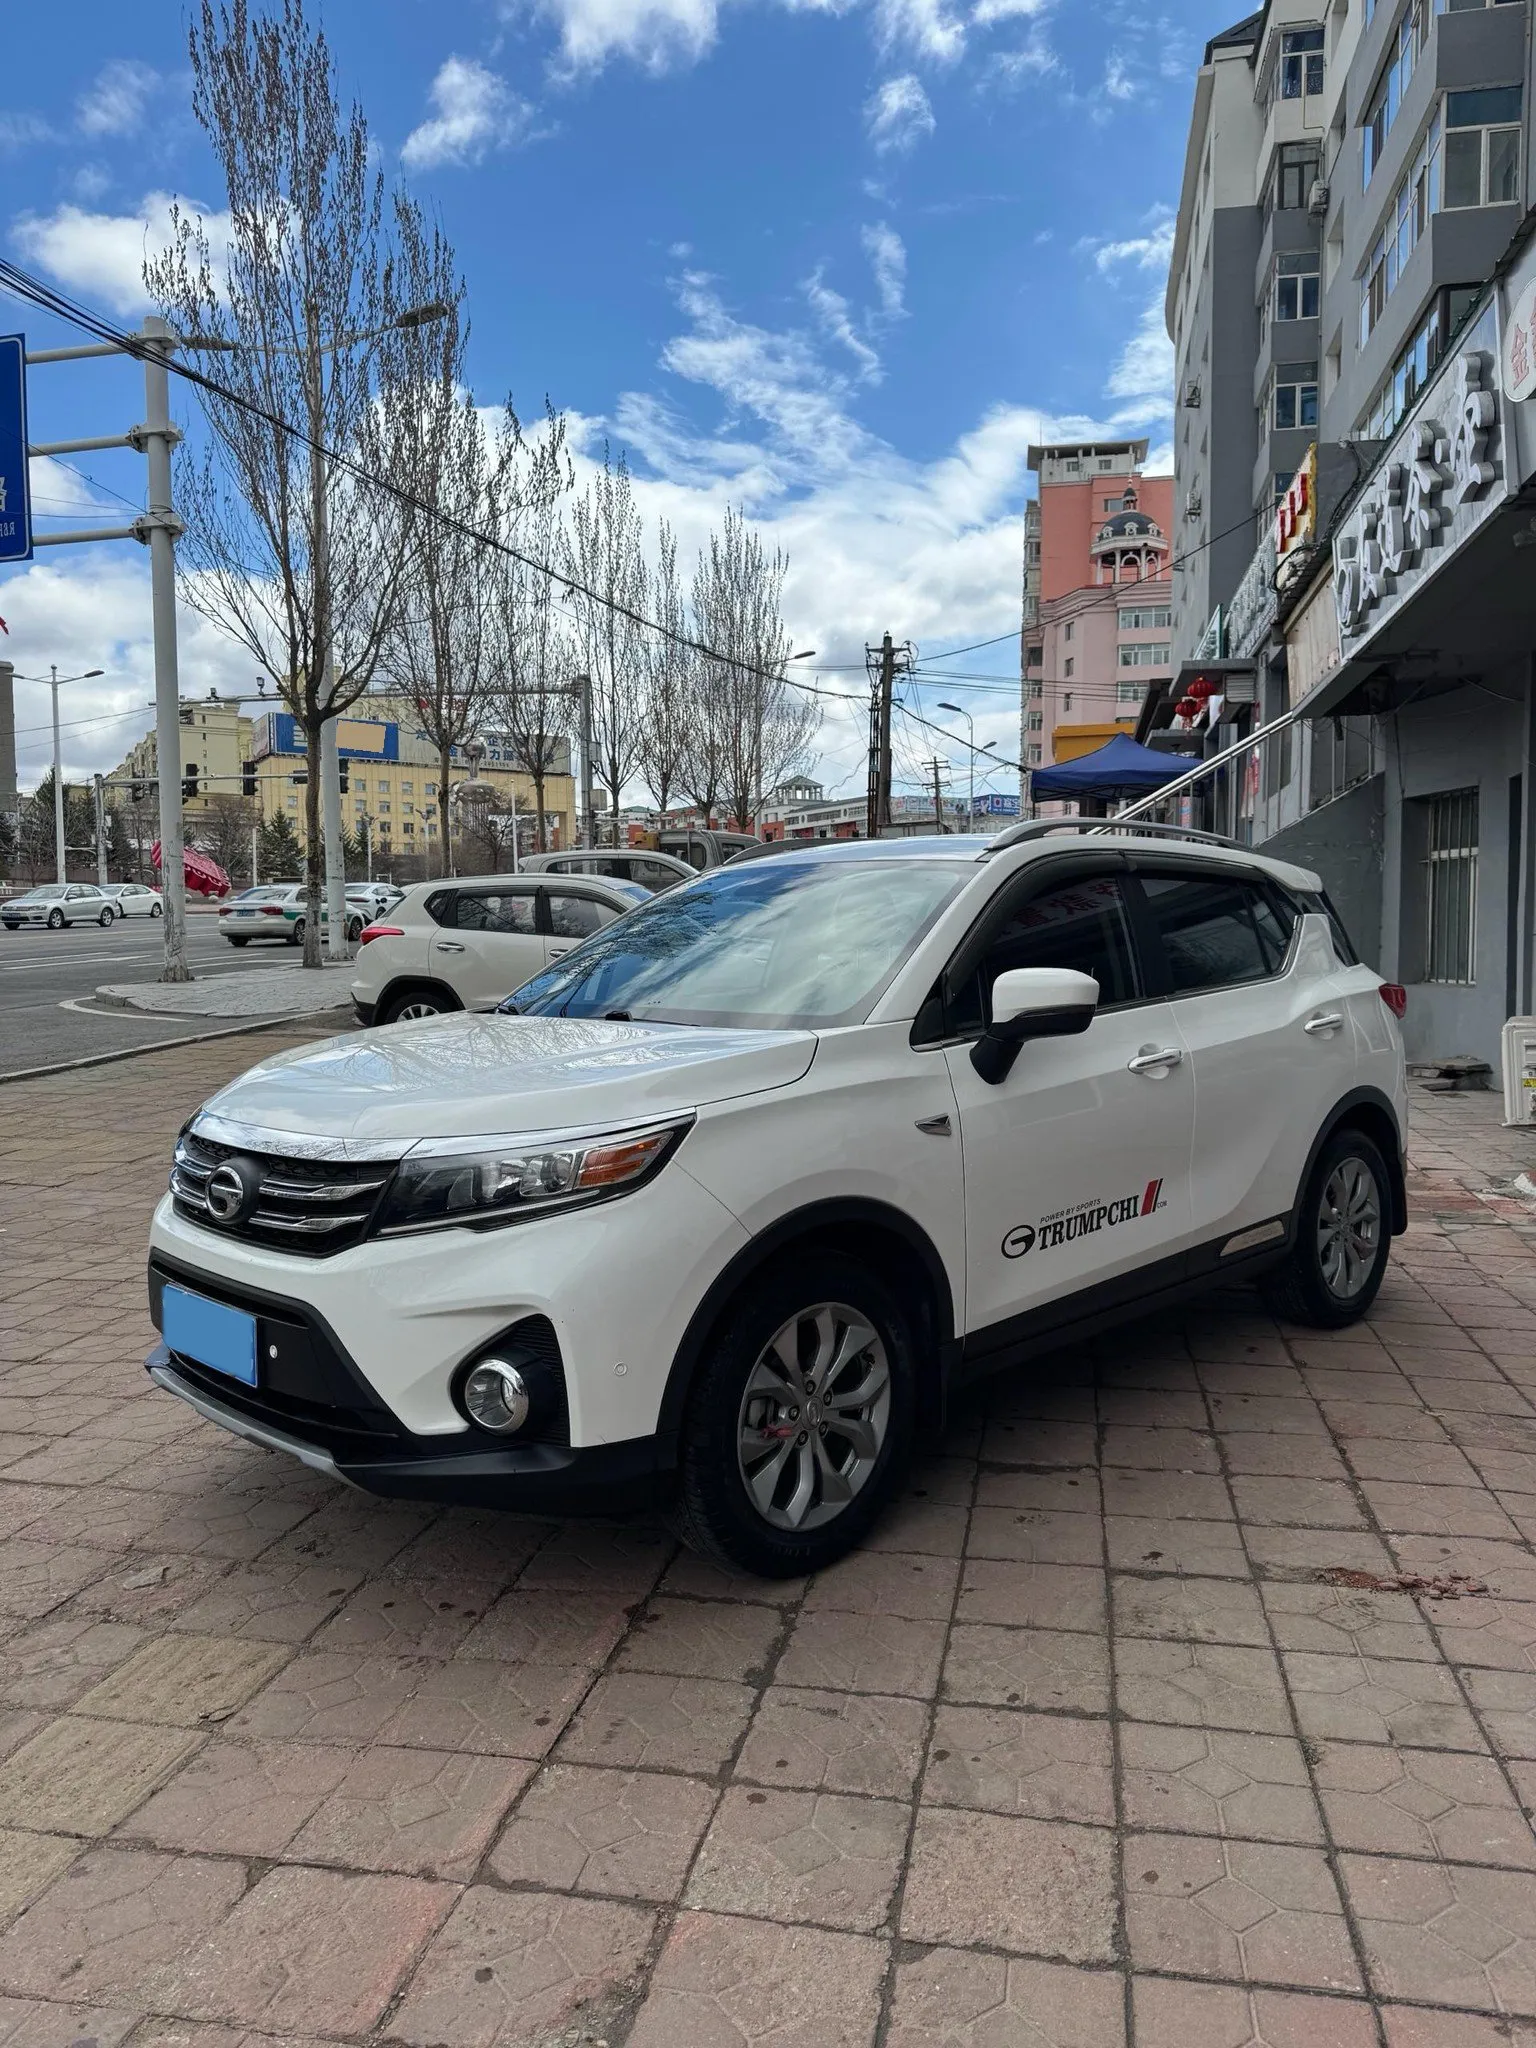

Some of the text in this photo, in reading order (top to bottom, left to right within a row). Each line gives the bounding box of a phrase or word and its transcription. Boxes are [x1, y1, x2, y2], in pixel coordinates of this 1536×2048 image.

[1038, 1194, 1140, 1251] TRUMPCHI
[1040, 1198, 1102, 1224] POWER BY SPORTS
